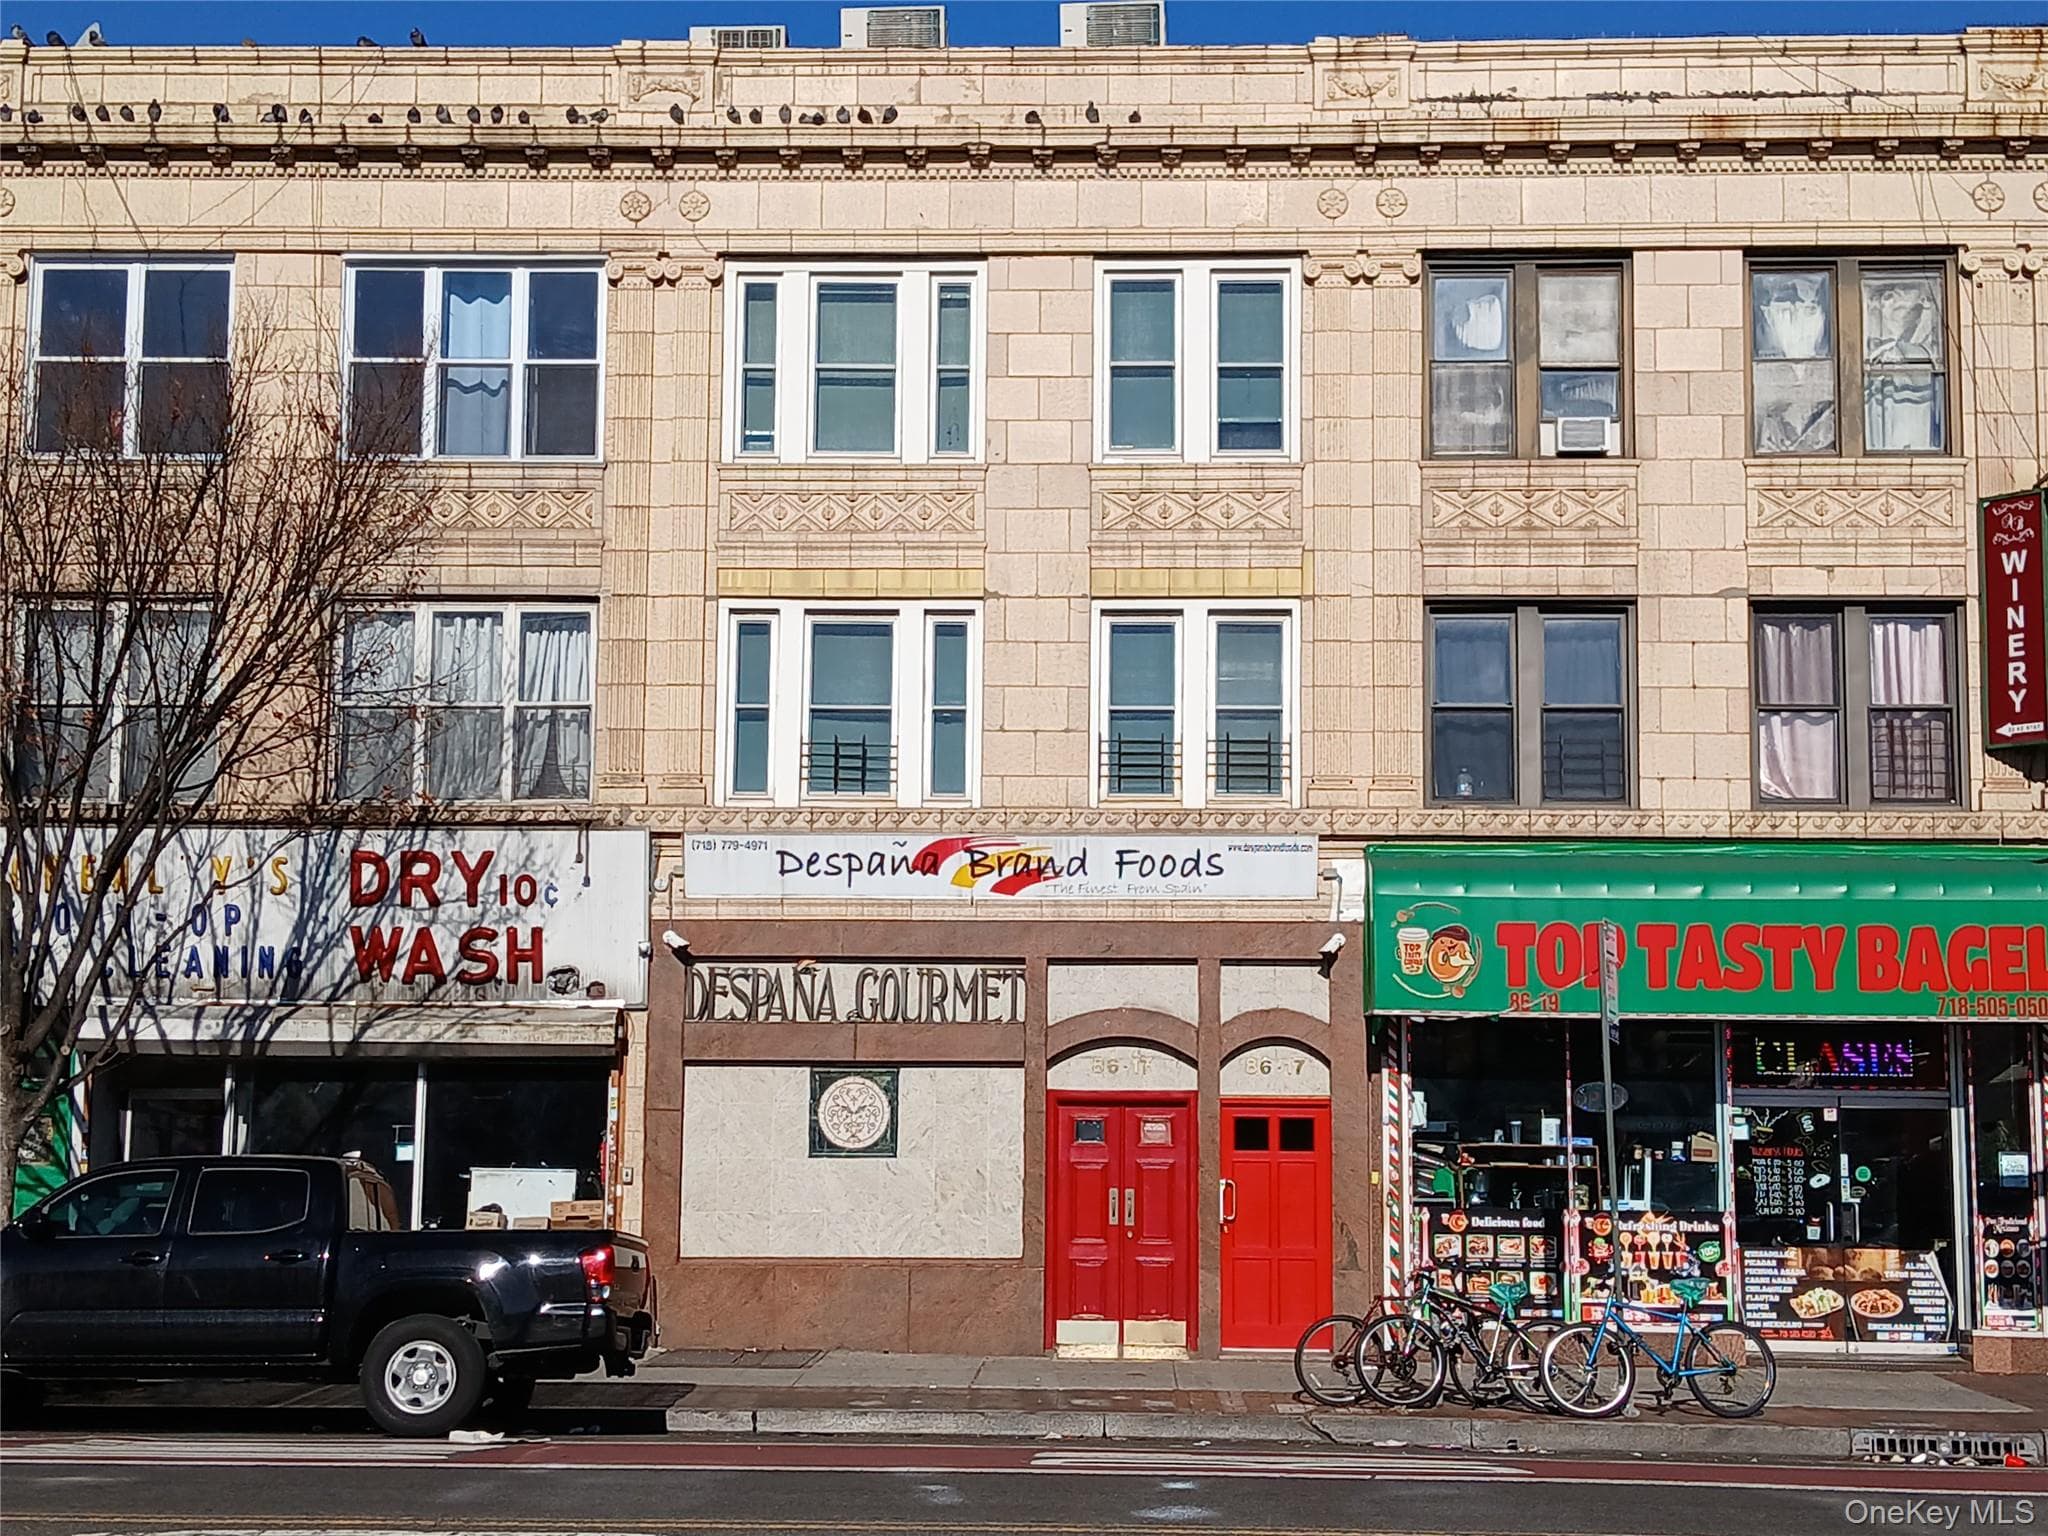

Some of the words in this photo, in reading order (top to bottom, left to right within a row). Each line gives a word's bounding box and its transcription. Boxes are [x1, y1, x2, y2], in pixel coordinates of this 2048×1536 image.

[2001, 549, 2027, 713] WINERY
[691, 840, 716, 851] (718)
[721, 840, 768, 851] 779-4971
[776, 841, 939, 888] Despaña
[964, 847, 1088, 878] Brand
[1115, 848, 1224, 879] Foods
[350, 850, 495, 908] DRY
[1078, 882, 1118, 895] Finest
[1127, 883, 1160, 894] From
[350, 927, 544, 985] WASH
[1497, 921, 1626, 990] TOP
[1636, 923, 1847, 993] TASTY
[1857, 924, 2048, 993] BAGEL
[684, 963, 838, 1022] DESPAÑA
[856, 966, 1026, 1022] GOURMET
[1471, 1216, 1520, 1228] Delicious
[1522, 1216, 1545, 1228] food
[1679, 1220, 1720, 1233] Drinks
